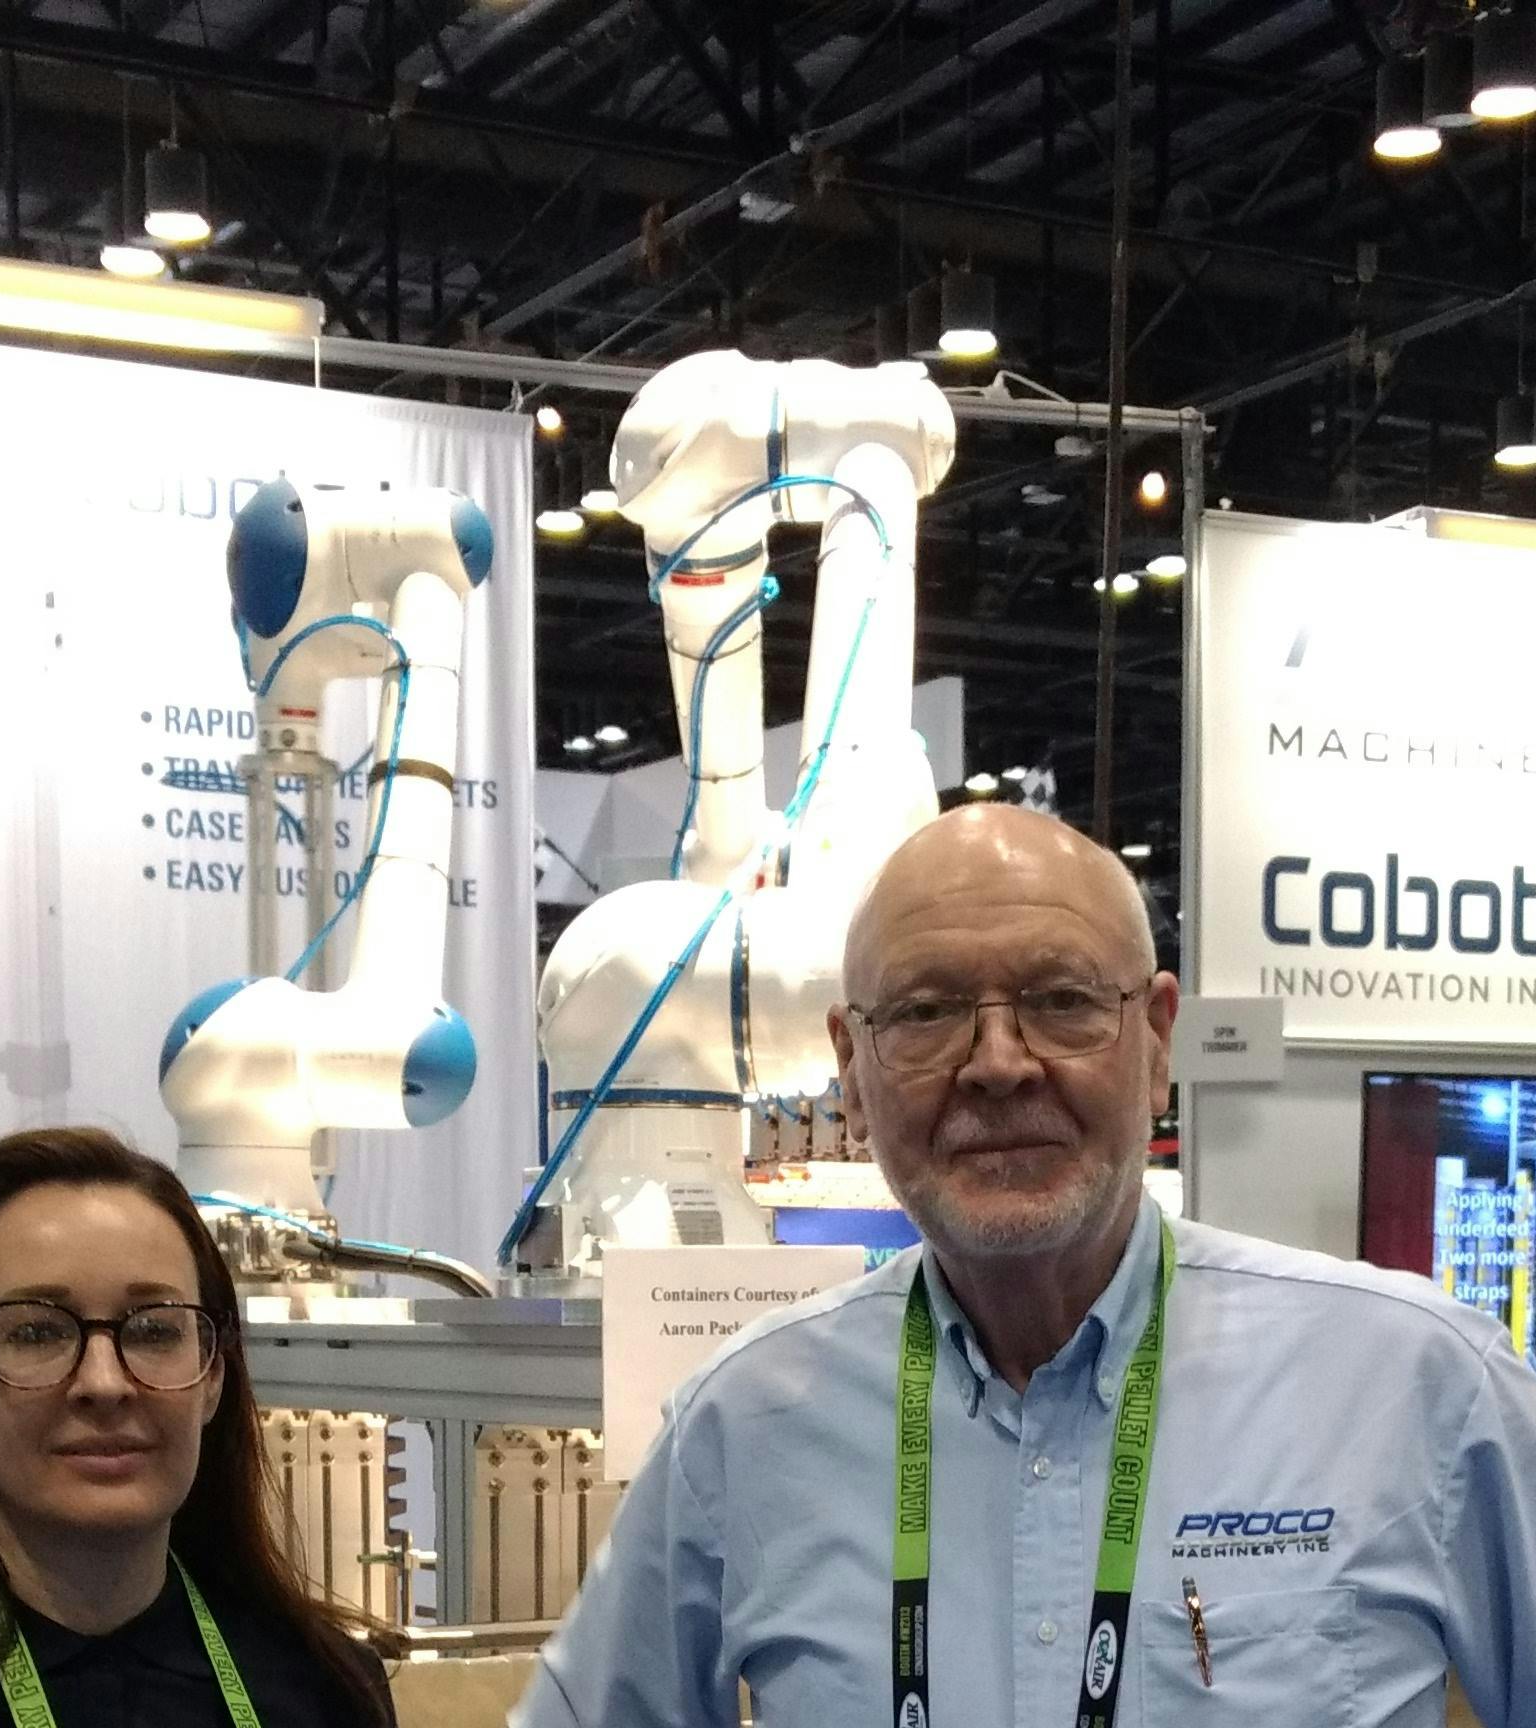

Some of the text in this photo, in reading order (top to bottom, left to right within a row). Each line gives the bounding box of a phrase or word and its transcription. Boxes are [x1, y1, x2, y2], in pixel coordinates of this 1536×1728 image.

[164, 705, 255, 741] RAPID
[165, 808, 243, 843] CASE
[166, 861, 243, 894] EASY
[1259, 966, 1489, 1004] INNOVATION
[1446, 1190, 1523, 1214] Applying
[1478, 1252, 1526, 1267] more
[651, 1286, 729, 1302] Containers
[733, 1286, 798, 1305] Courtesy
[1454, 1283, 1508, 1304] straps
[659, 1321, 704, 1336] Aaron
[901, 1379, 930, 1456] EVERY
[1118, 1360, 1156, 1449] PELLET
[900, 1460, 927, 1534] MAKE
[1104, 1455, 1144, 1545] COUNT
[1175, 1507, 1335, 1537] PROCO
[1171, 1542, 1330, 1558] MACHINERY INC
[202, 1629, 244, 1696] EVERY
